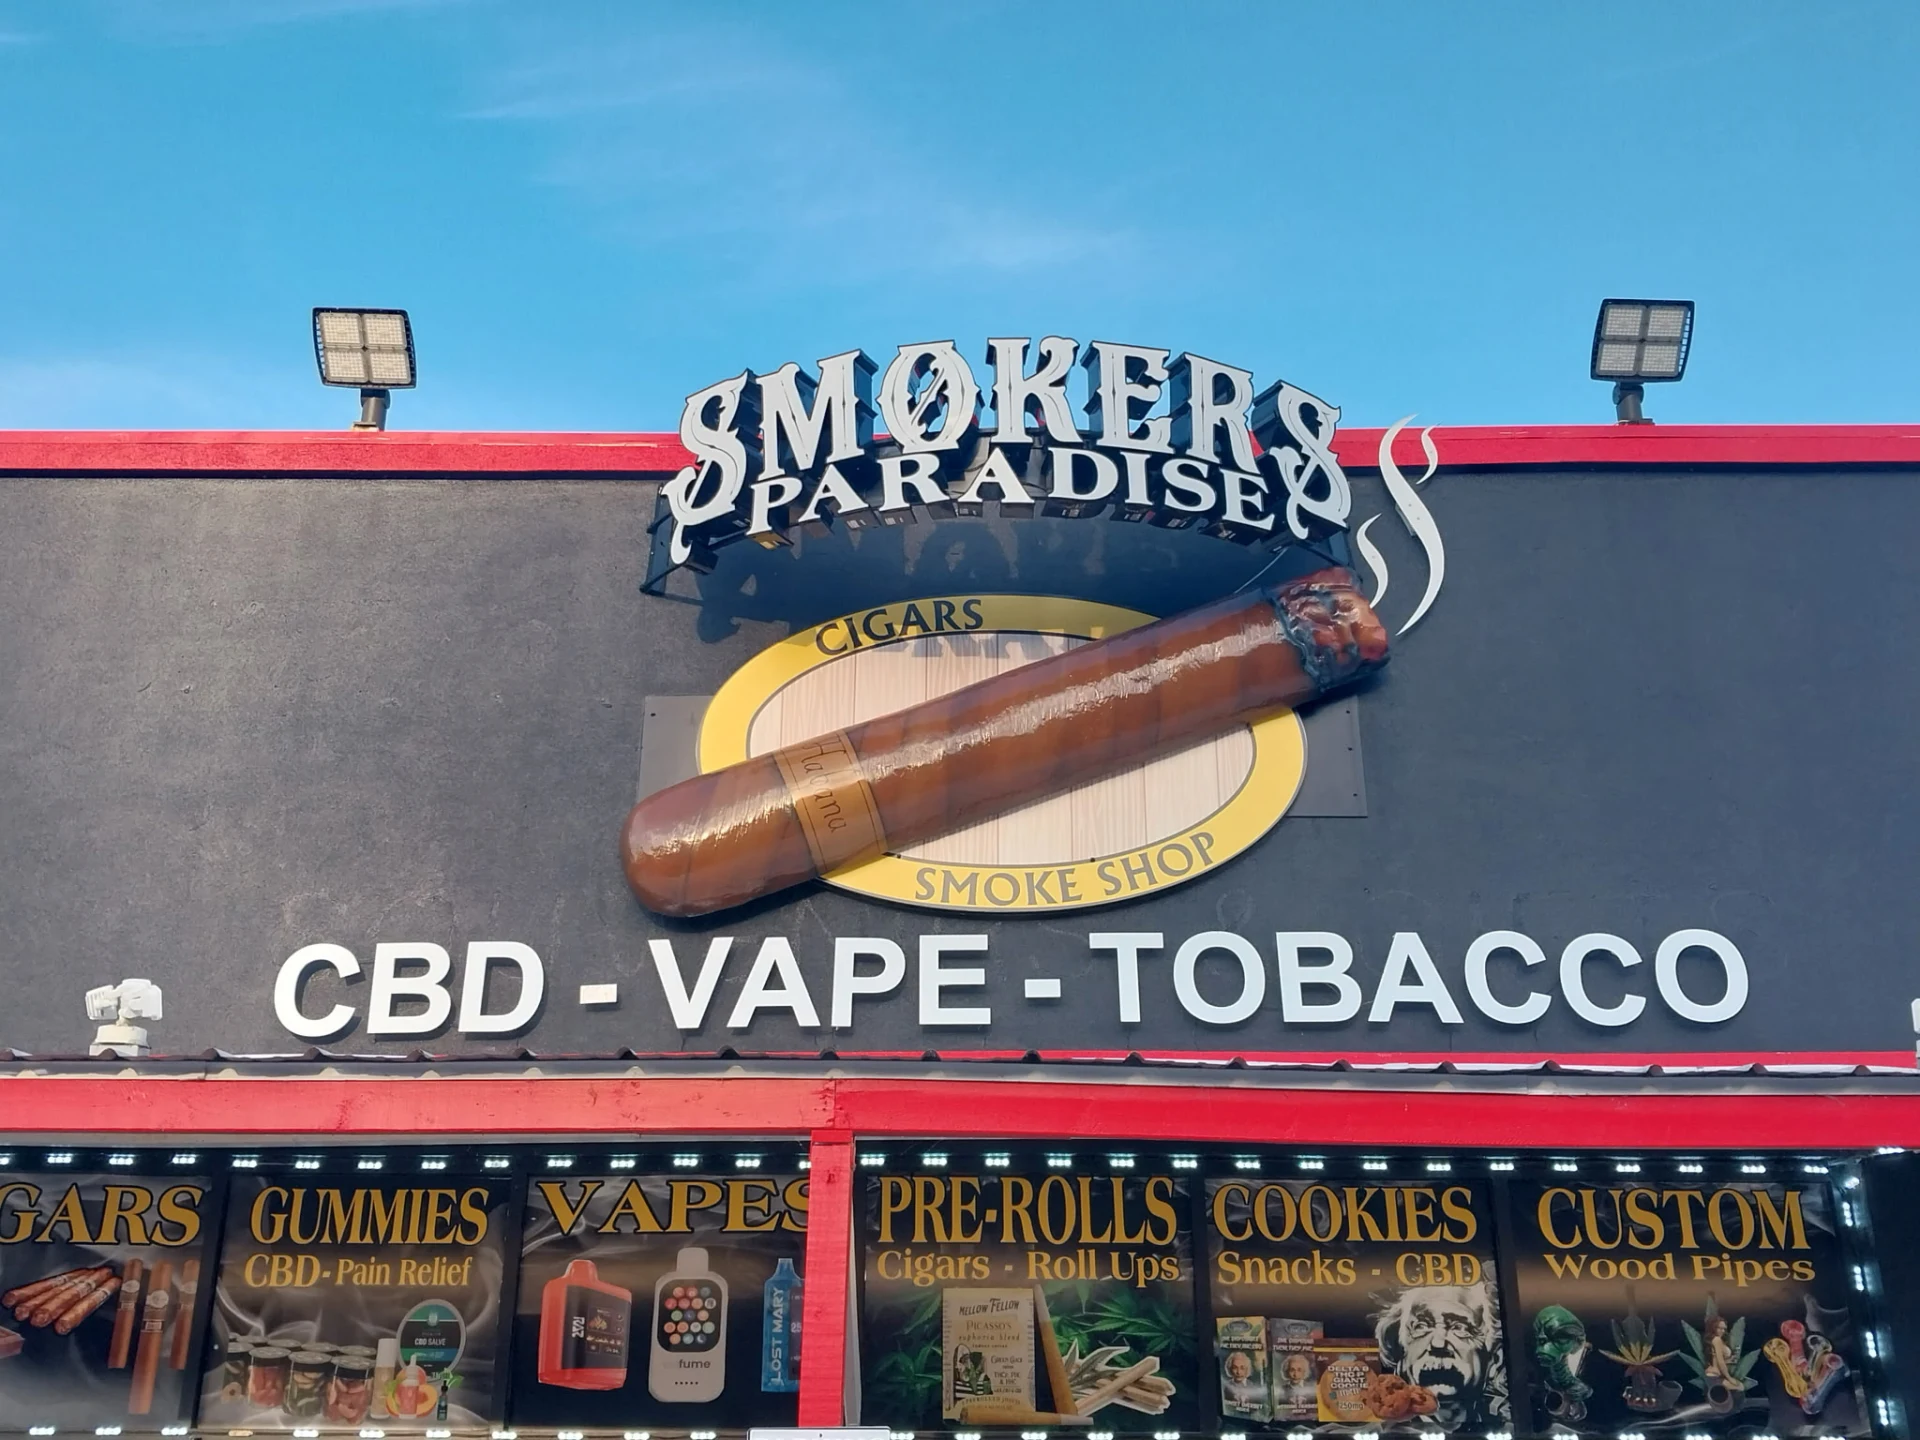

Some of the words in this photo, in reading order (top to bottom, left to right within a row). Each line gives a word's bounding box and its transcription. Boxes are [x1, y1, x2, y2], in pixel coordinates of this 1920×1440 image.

[746, 447, 1275, 535] PARADISE
[815, 599, 984, 656] CIGARS
[915, 867, 1083, 906] SMOKE
[1096, 831, 1215, 896] SHOP
[273, 941, 545, 1037] CBD
[647, 934, 991, 1030] VAPE
[1089, 929, 1749, 1026] TOBACCO
[250, 1186, 489, 1246] GUMMIES
[877, 1175, 1178, 1245] PRE-ROLLS
[1212, 1183, 1477, 1243] COOKIES
[1537, 1187, 1812, 1250] CUSTOM
[400, 1256, 474, 1287] Relief
[877, 1248, 991, 1287] Cigars
[1027, 1249, 1098, 1280] Roll
[1109, 1251, 1180, 1288] Ups
[1217, 1250, 1356, 1285] Snacks
[1395, 1253, 1482, 1287] CBD
[1543, 1252, 1677, 1281] Wood
[1690, 1253, 1816, 1287] Pipes
[772, 1287, 784, 1333] MARY
[959, 1304, 988, 1316] MELLOW
[989, 1298, 1020, 1313] FELLOW
[679, 1359, 711, 1369] fume
[770, 1337, 784, 1386] LOST
